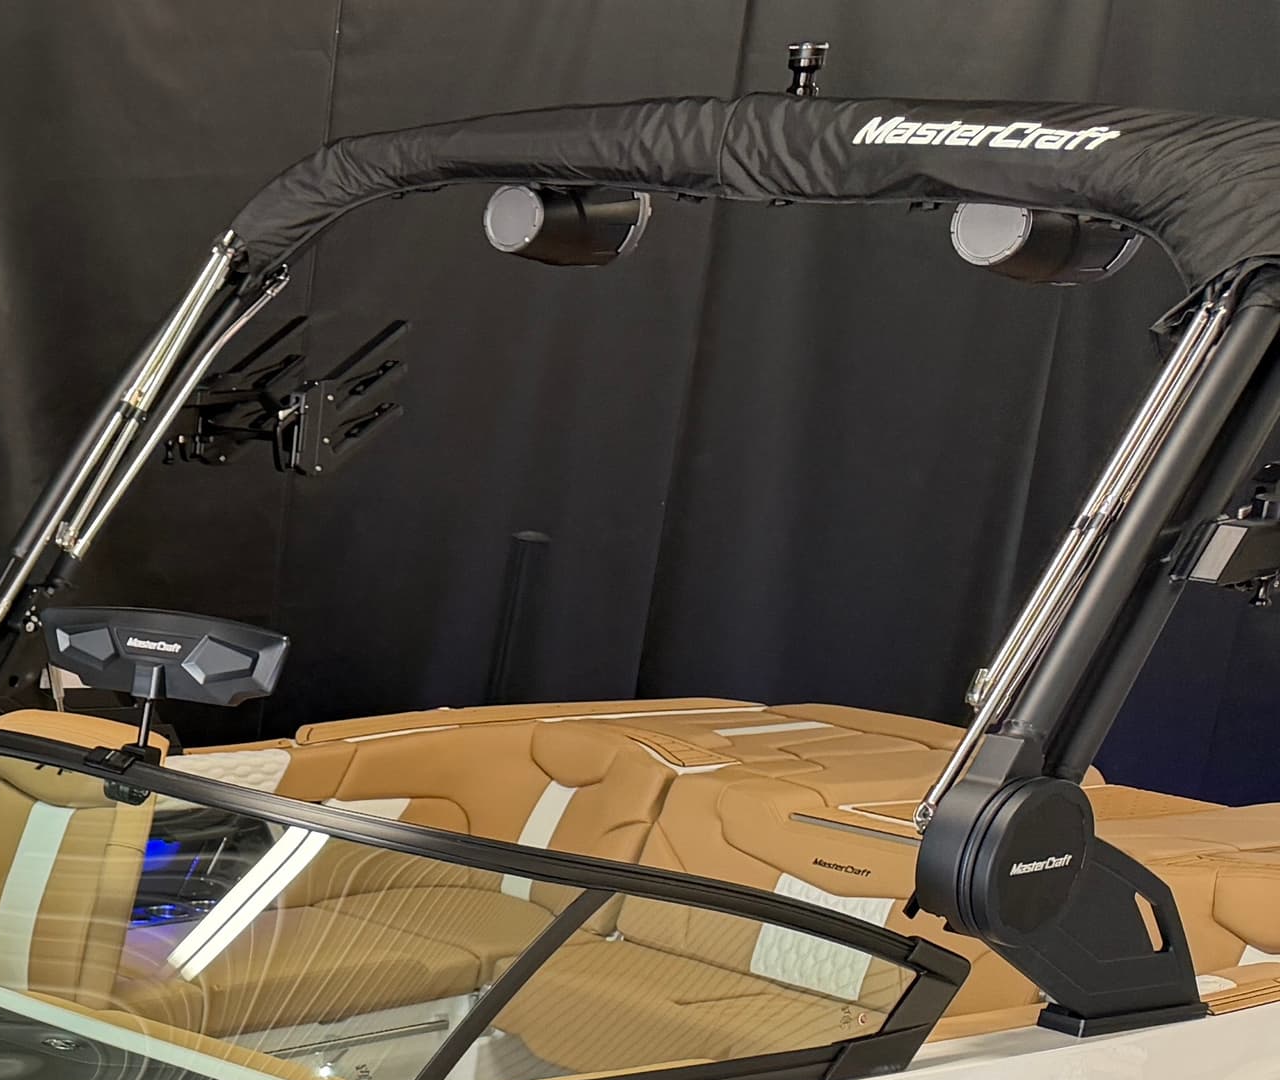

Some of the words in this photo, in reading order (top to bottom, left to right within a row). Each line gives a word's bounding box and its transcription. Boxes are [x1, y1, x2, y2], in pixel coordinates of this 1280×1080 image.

[852, 115, 1121, 151] MasterCraft
[126, 636, 182, 653] MasterCraft
[812, 858, 872, 877] MasterCraft
[1009, 853, 1073, 877] MasterCraft
